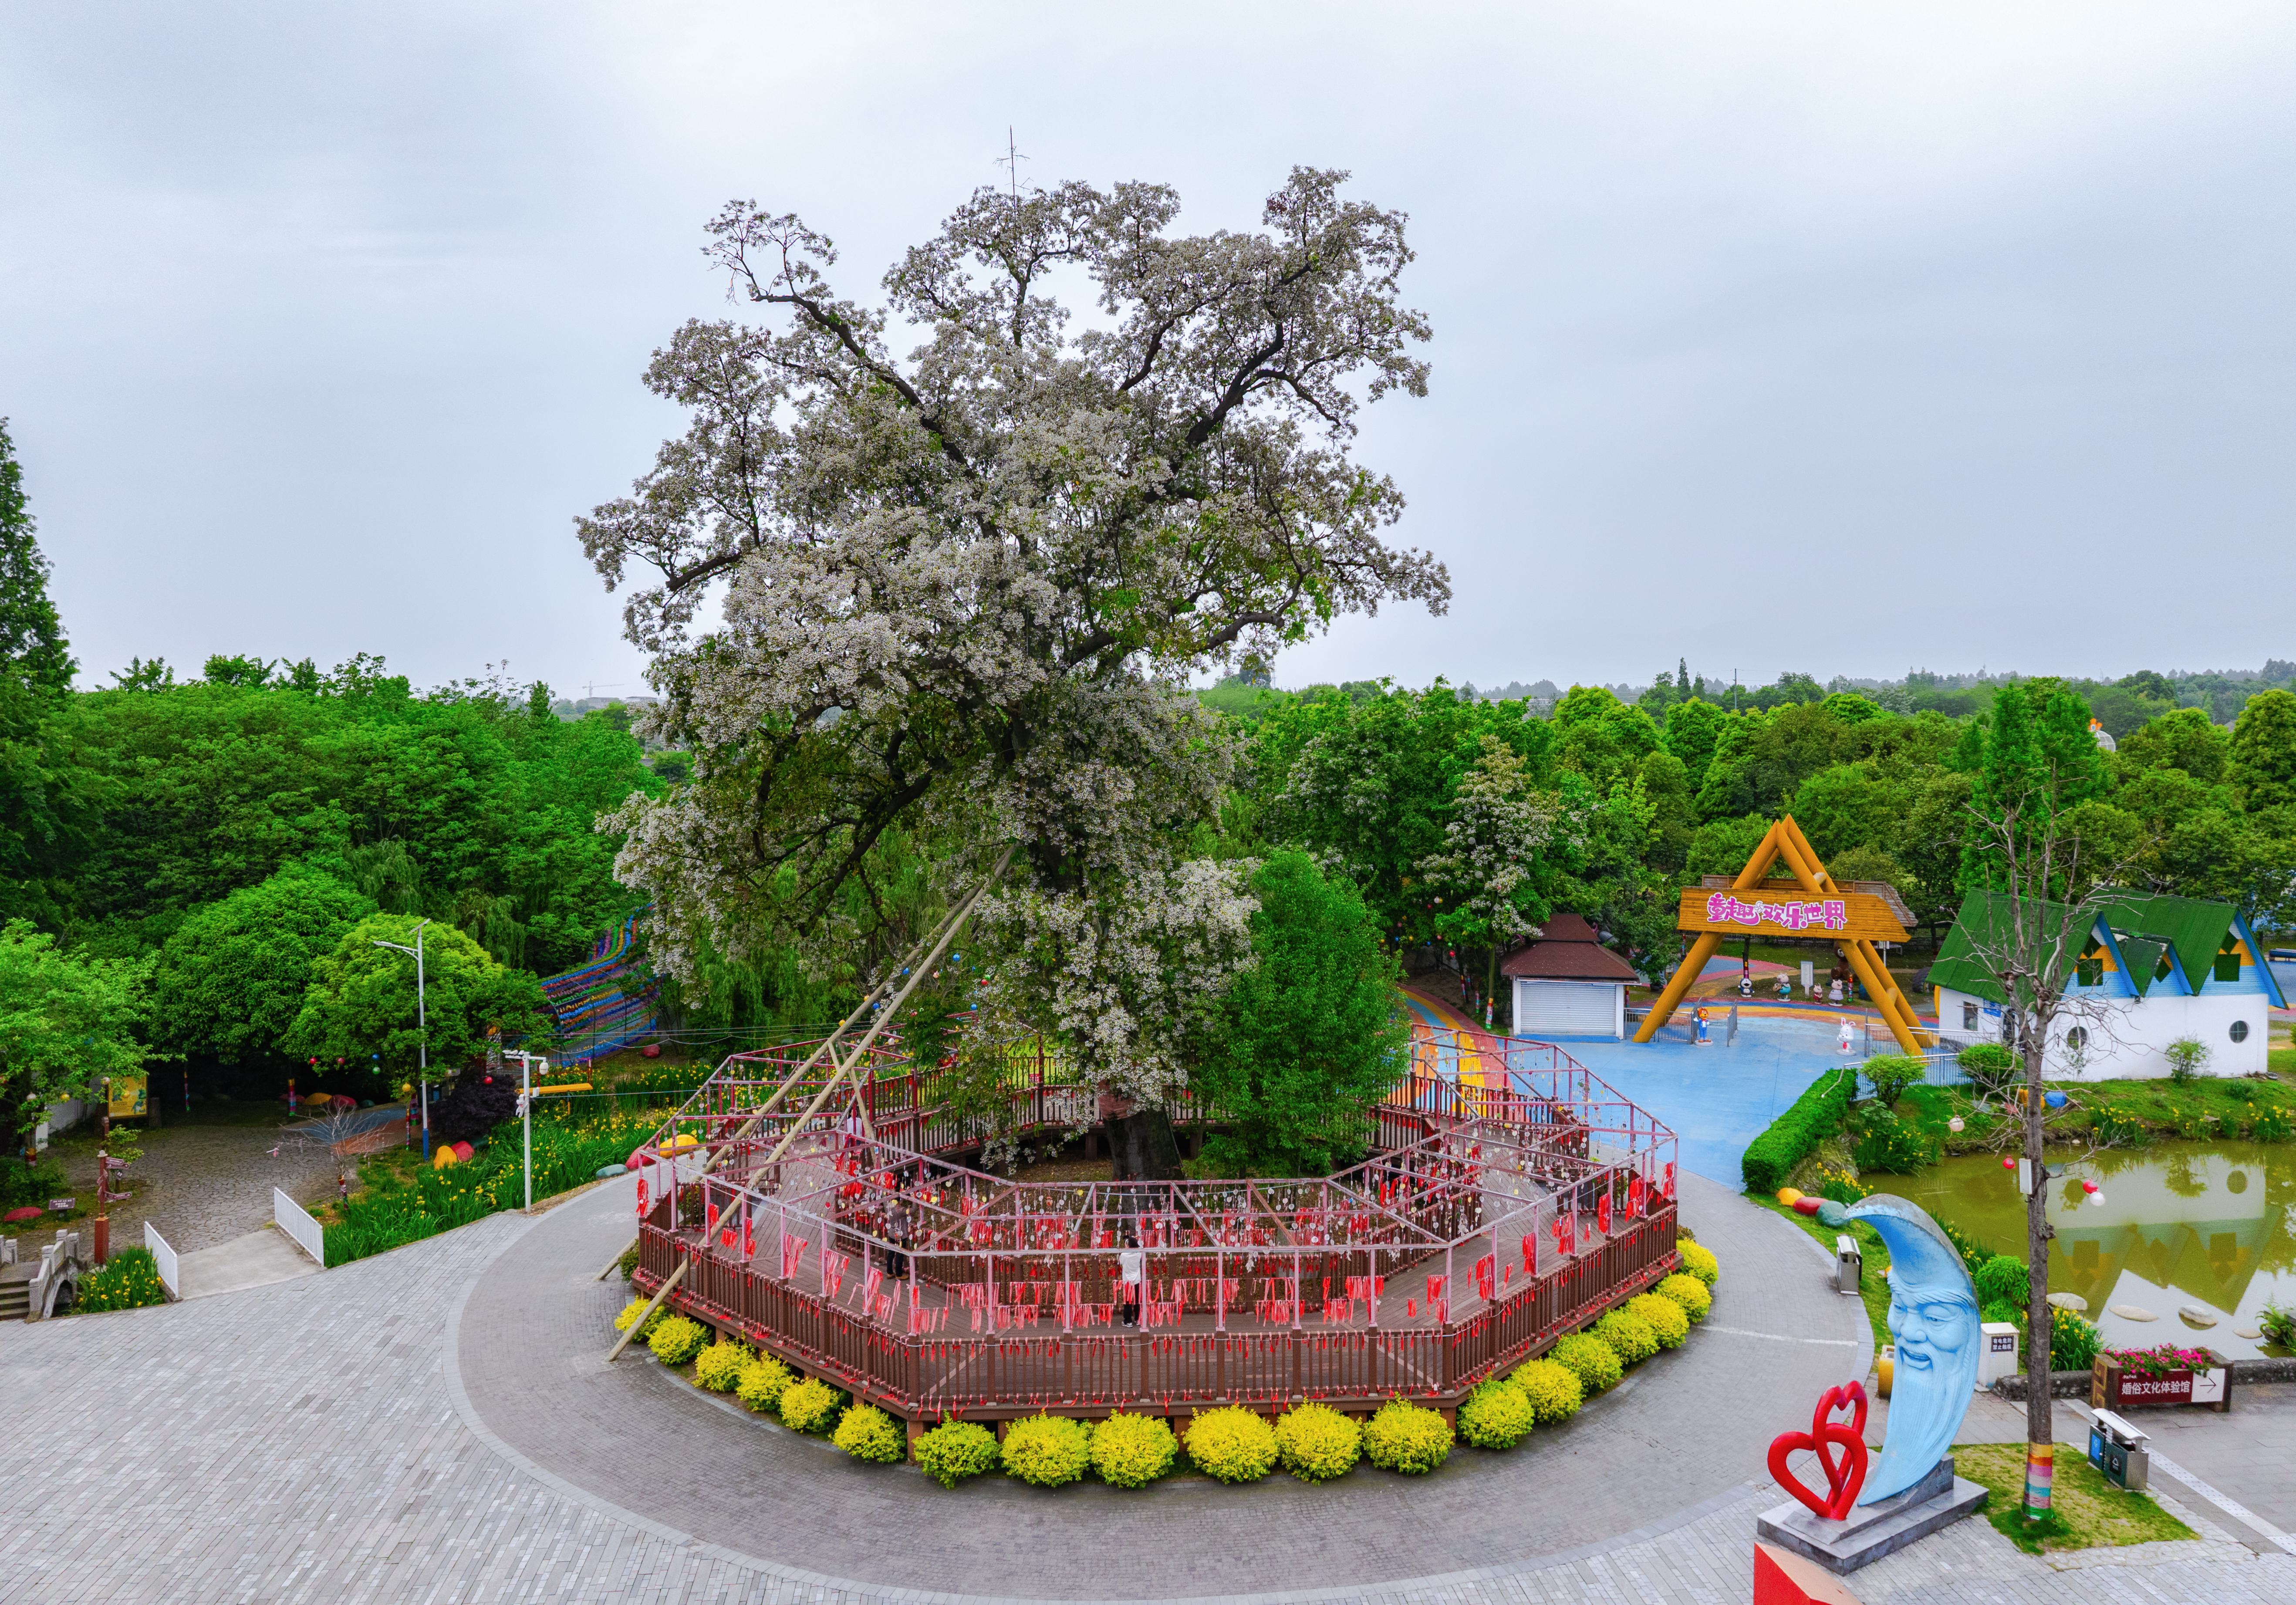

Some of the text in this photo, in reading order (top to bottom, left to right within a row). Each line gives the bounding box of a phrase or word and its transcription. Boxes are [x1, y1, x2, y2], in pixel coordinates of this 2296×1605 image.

[1707, 892, 1847, 930] 童趣欢乐世界
[2122, 1380, 2190, 1395] 婚俗文化体验馆
